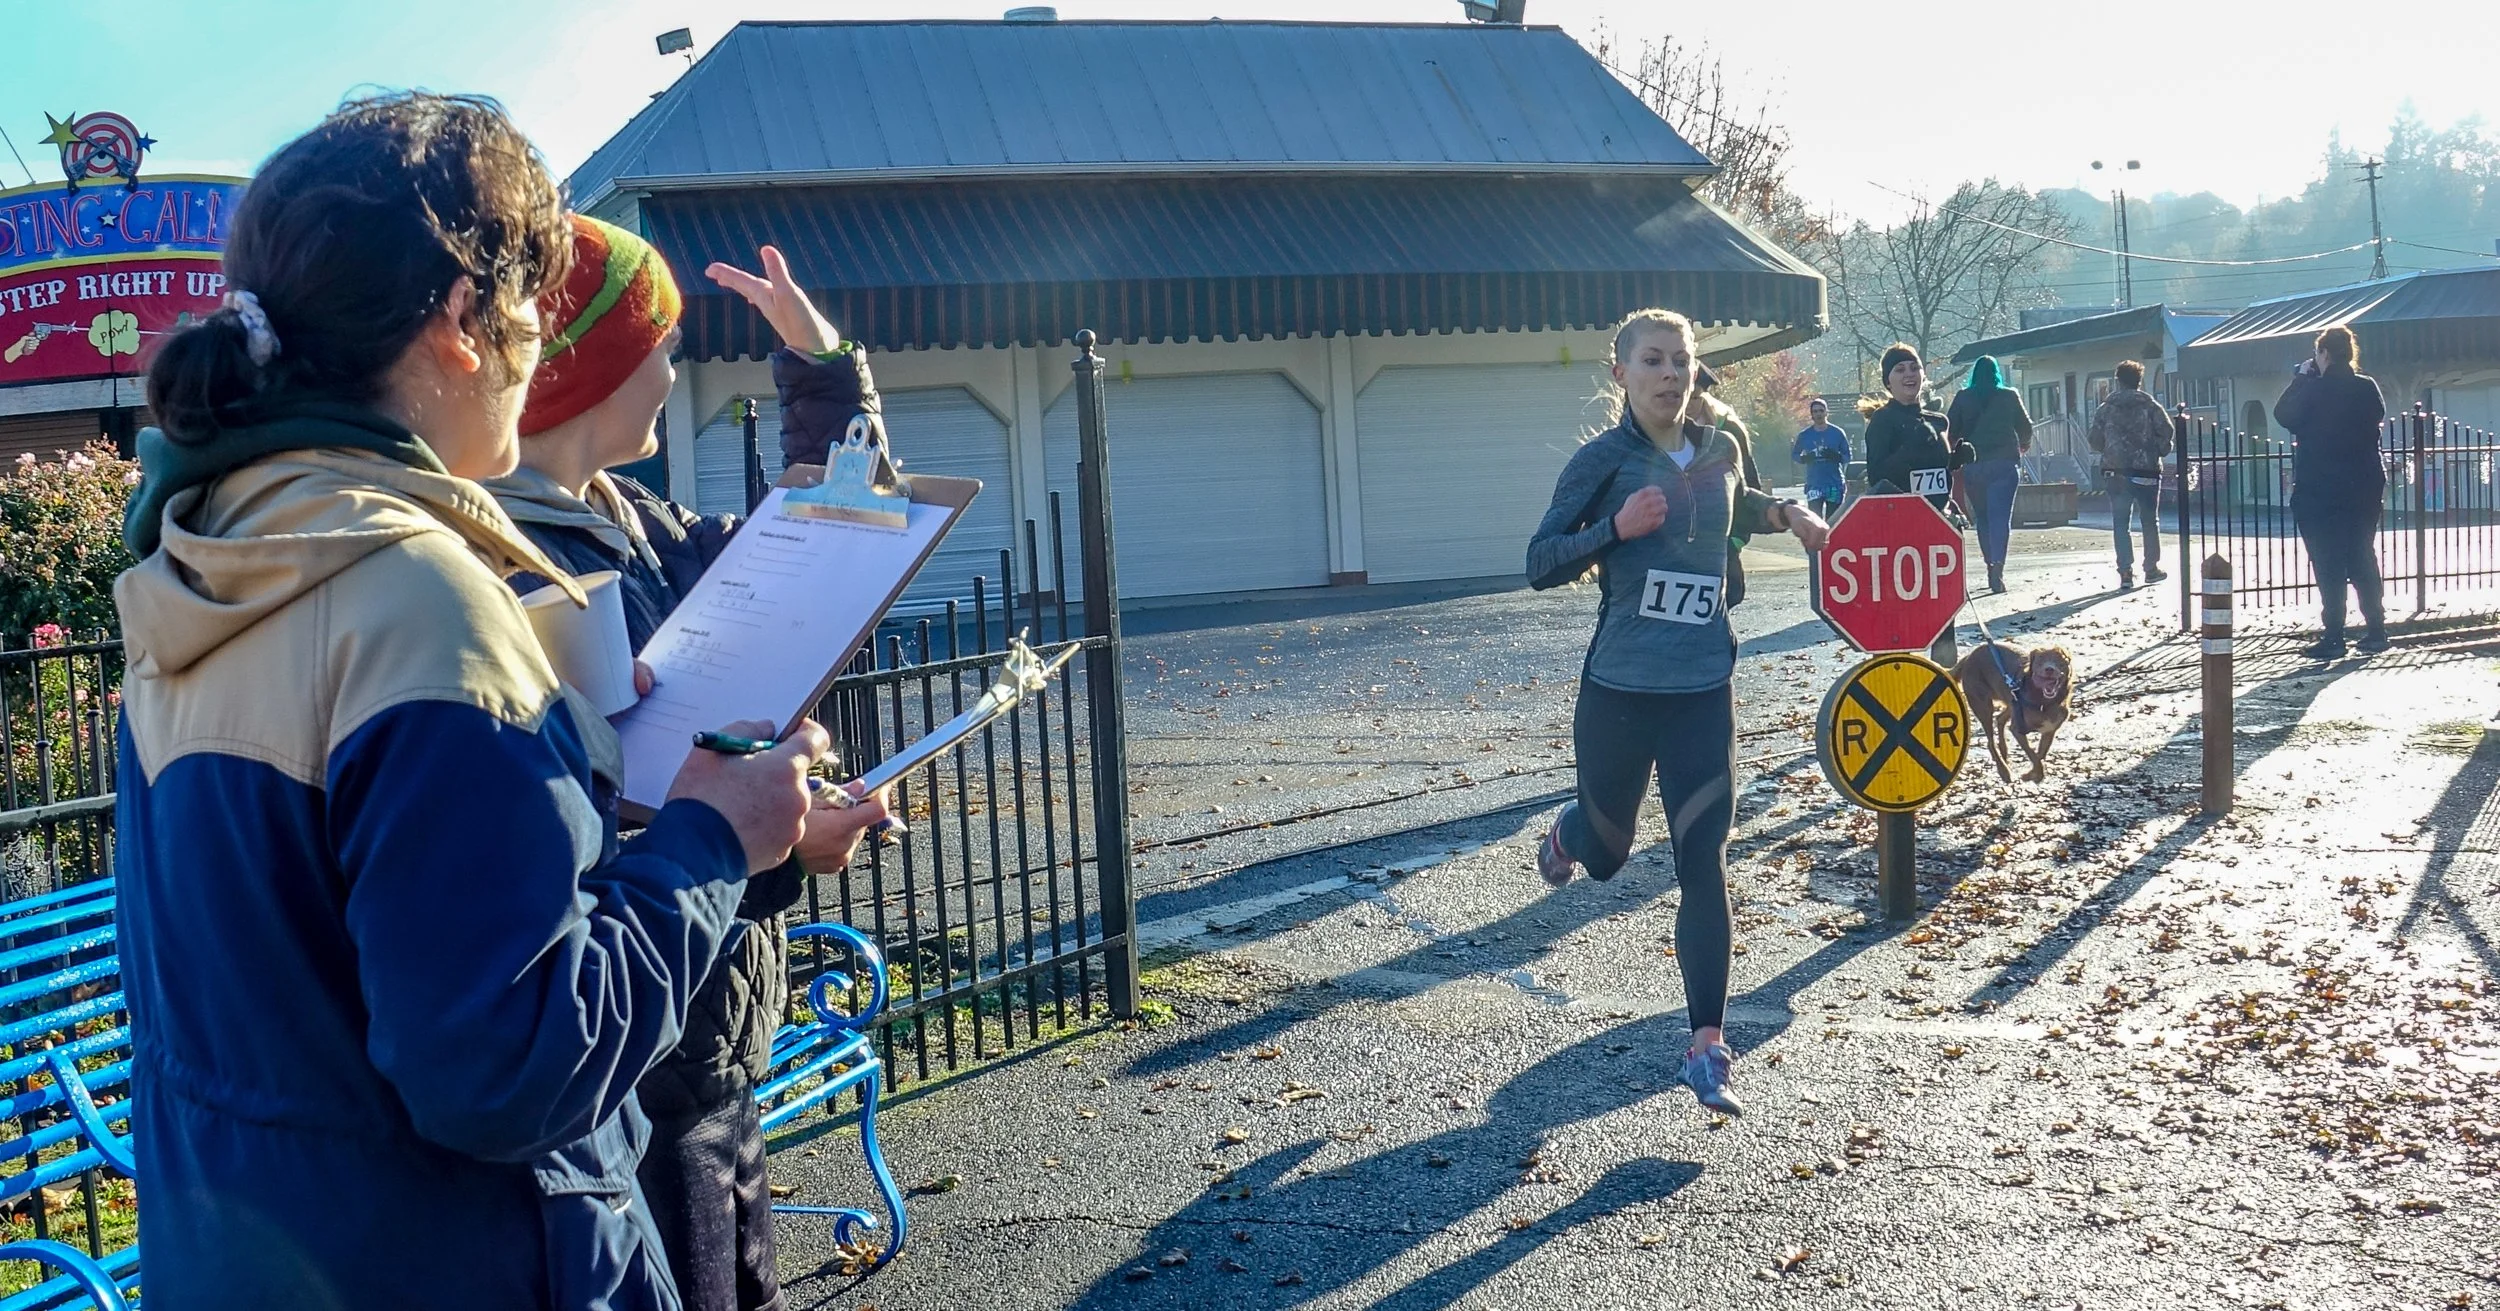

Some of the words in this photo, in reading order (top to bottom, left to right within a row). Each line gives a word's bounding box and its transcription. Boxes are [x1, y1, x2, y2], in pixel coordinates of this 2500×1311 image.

[77, 270, 176, 300] RIGHT
[186, 272, 227, 297] UP
[1912, 470, 1945, 491] 776
[1829, 544, 1957, 604] STOP
[1646, 580, 1715, 619] 175
[1842, 719, 1869, 756] R
[1933, 712, 1960, 748] R
